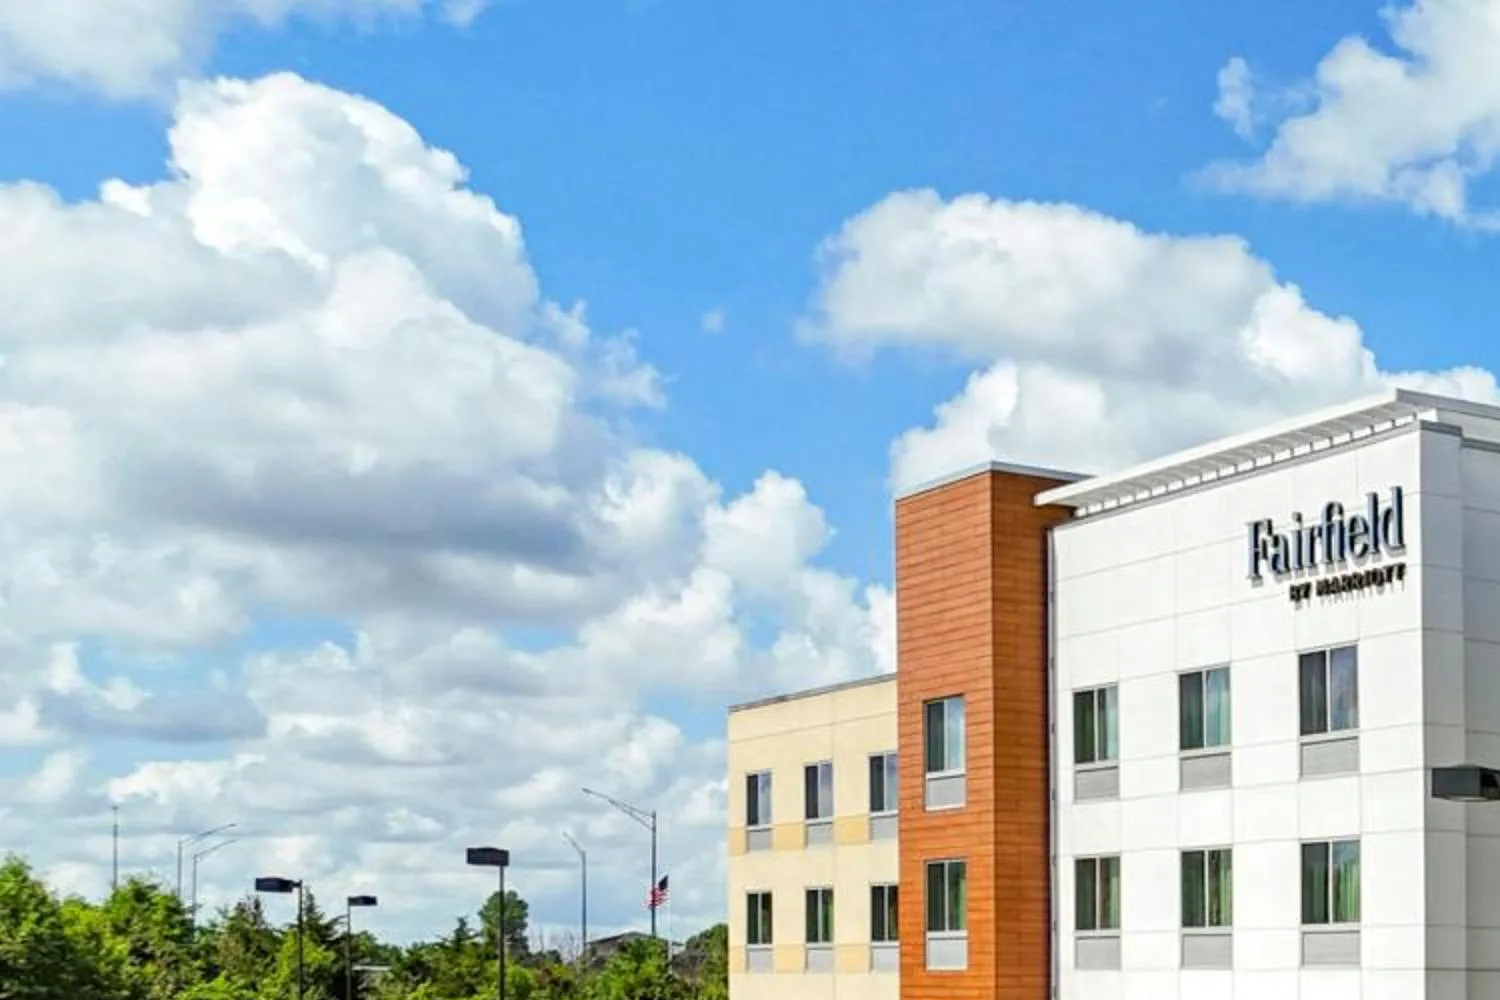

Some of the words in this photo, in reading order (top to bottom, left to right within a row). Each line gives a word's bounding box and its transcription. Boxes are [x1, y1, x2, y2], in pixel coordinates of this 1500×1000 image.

[1247, 485, 1406, 580] Fairfield
[1289, 582, 1312, 602] BY
[1315, 562, 1407, 597] MARRIOTT
